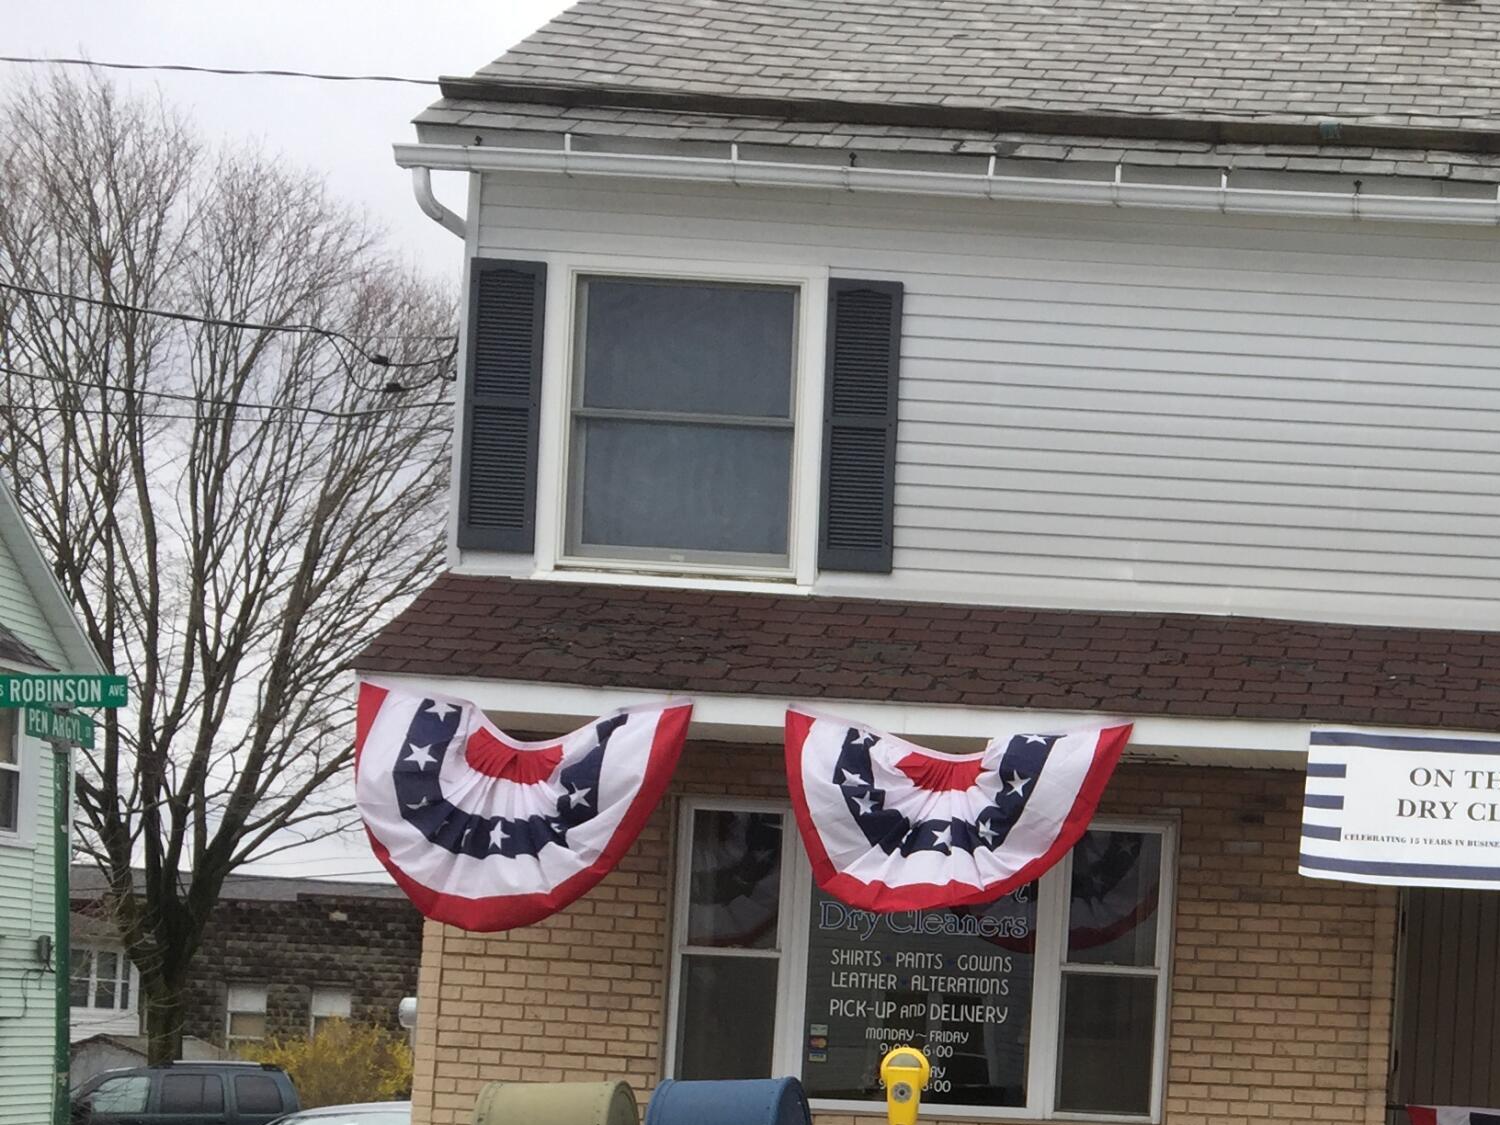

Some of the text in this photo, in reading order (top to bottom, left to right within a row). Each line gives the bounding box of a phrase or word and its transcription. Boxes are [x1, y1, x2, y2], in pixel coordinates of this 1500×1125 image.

[10, 679, 101, 702] ROBINSON
[108, 685, 125, 697] AVE
[28, 708, 48, 734] PEN
[52, 714, 83, 741] ARGYL
[1409, 767, 1455, 788] ON
[1396, 799, 1458, 820] DRY
[1344, 833, 1407, 844] CELEBRATING
[1410, 837, 1420, 845] 15
[1423, 838, 1452, 846] YEARS
[1455, 839, 1465, 847] IN
[819, 901, 1029, 941] Dry Cleaners
[830, 949, 1012, 973] SHIRTS PANTS GOWNS
[831, 971, 1009, 995] LEATHER ALTERATIONS
[829, 999, 1008, 1024] PICK-UP AND DELIVERY
[865, 1027, 915, 1042] MONDAY
[929, 1030, 969, 1044] FRIDAY
[923, 1044, 953, 1058] 6:00
